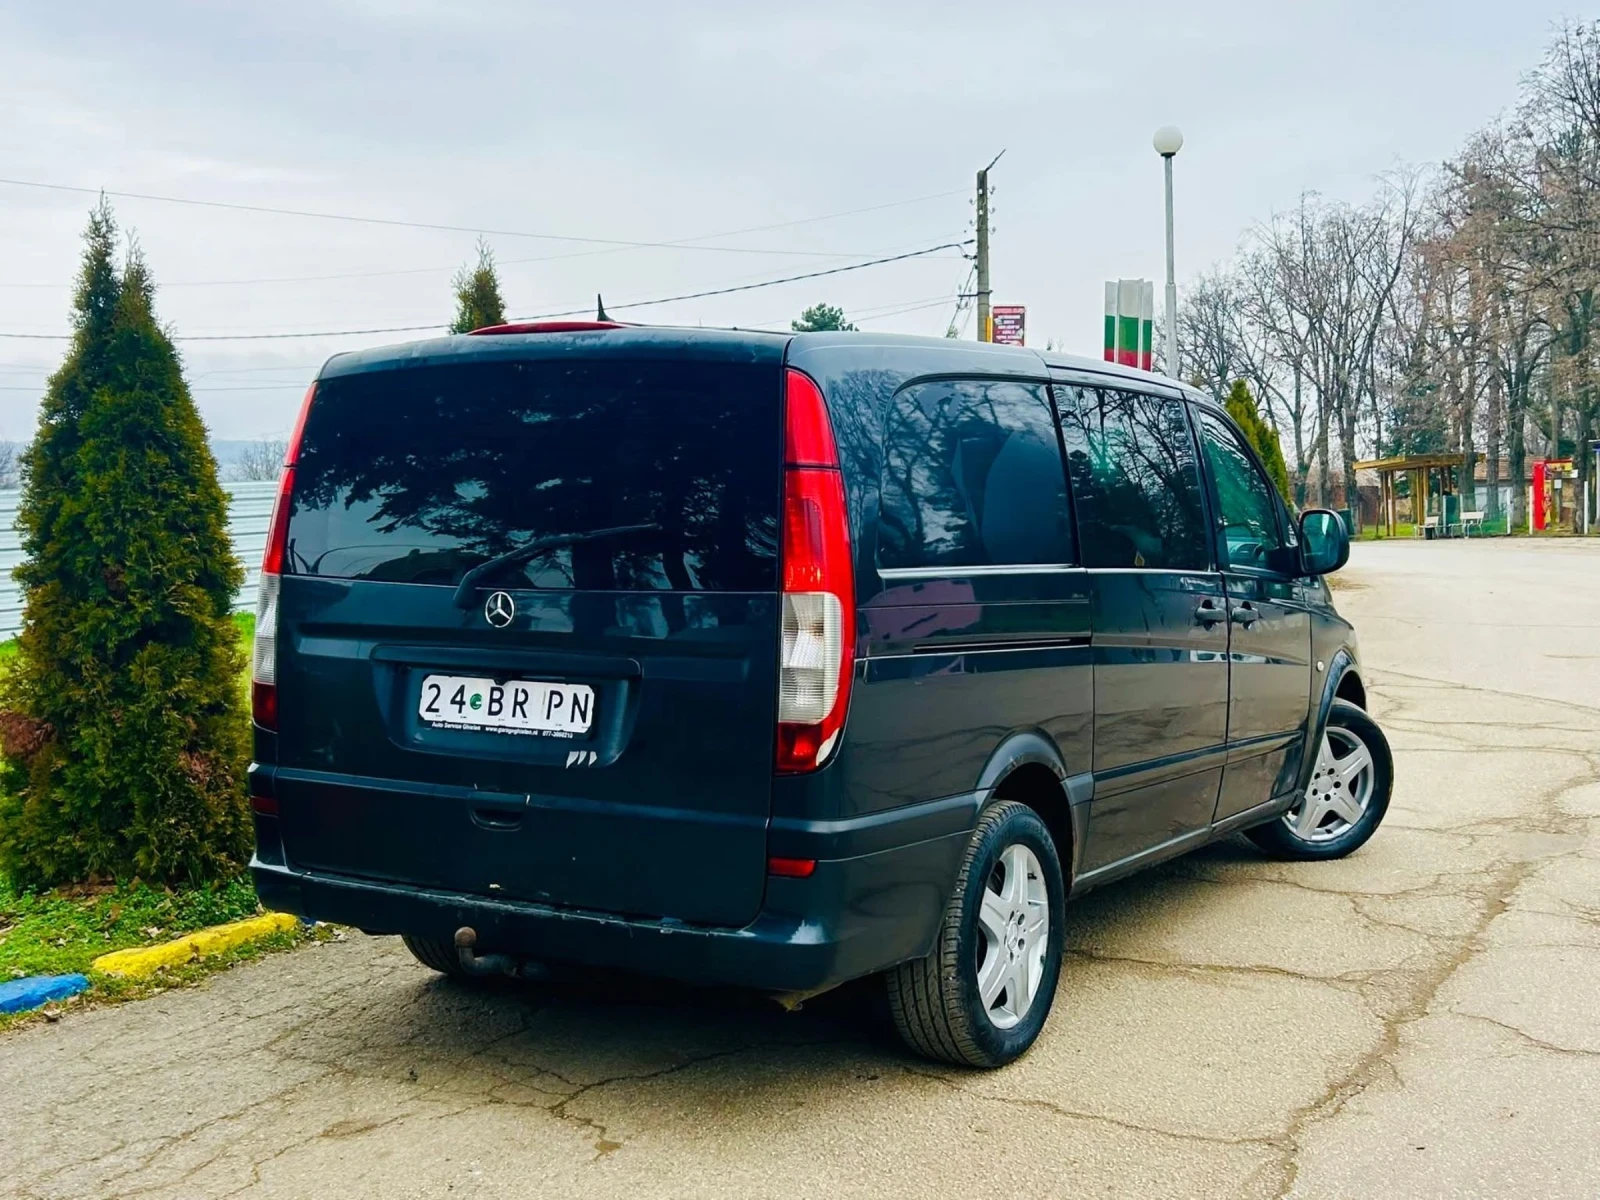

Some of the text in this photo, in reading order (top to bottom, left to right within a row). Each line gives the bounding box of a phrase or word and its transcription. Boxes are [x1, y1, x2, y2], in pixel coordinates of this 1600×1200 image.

[425, 683, 589, 724] 24 BR PN
[444, 722, 462, 730] Service
